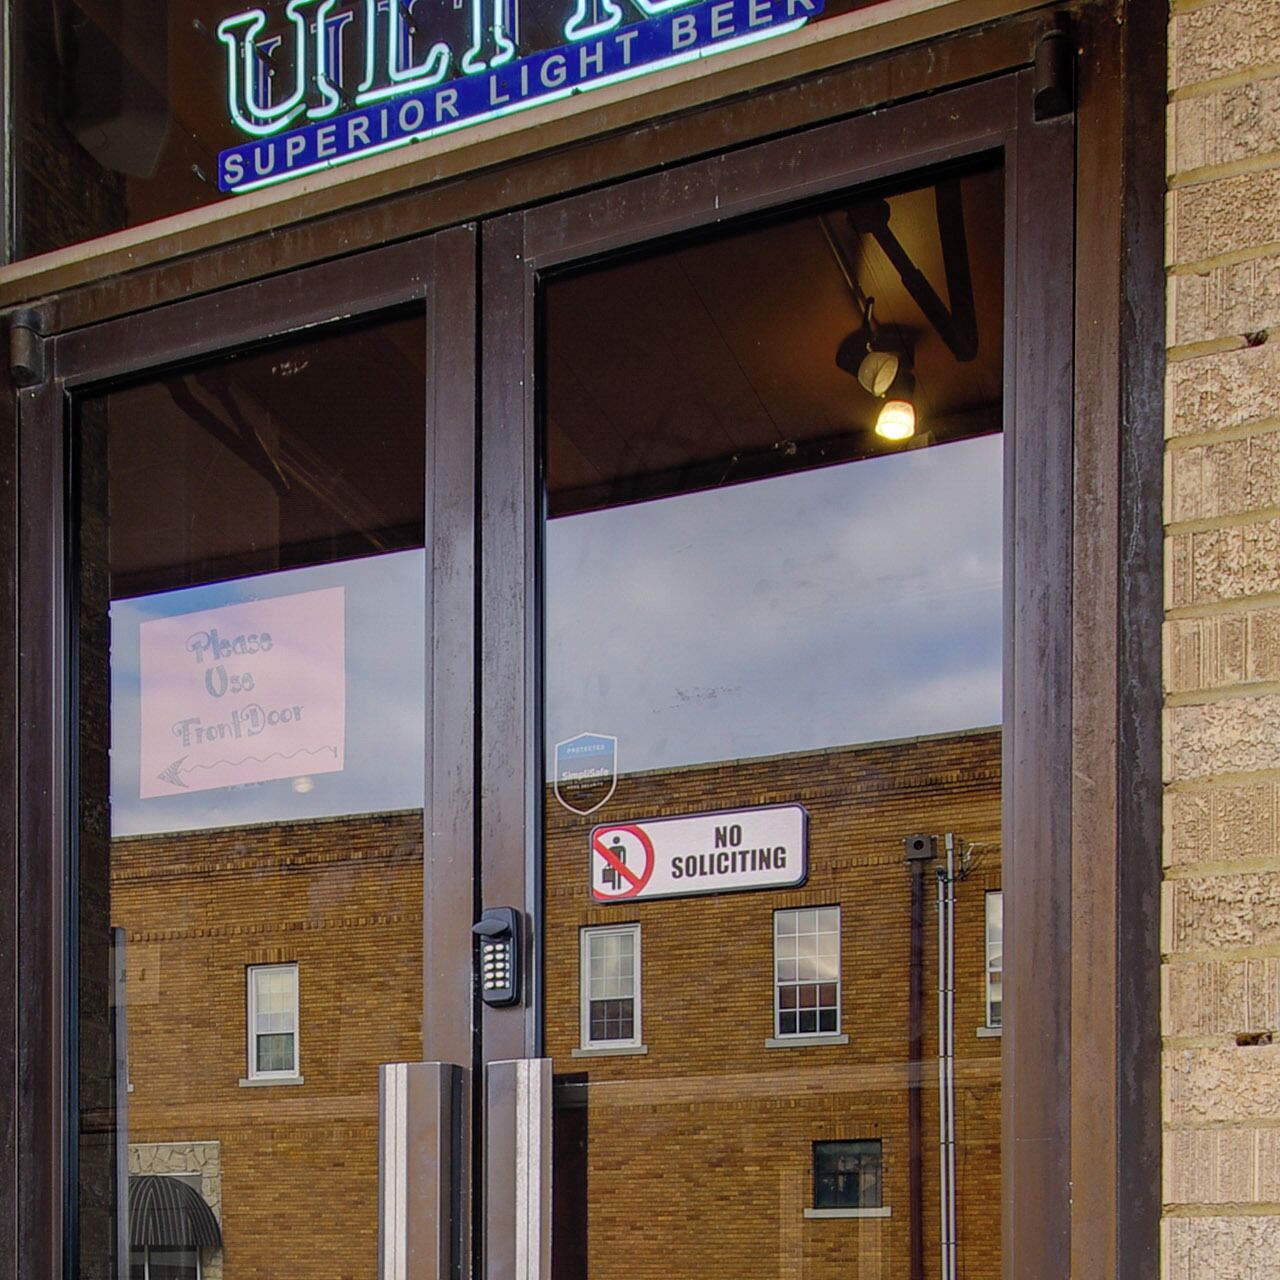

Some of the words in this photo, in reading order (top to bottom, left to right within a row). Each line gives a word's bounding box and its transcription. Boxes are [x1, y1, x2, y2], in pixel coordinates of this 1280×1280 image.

[223, 88, 459, 184] SUPERIOR
[489, 30, 639, 105] LIGHT
[185, 628, 274, 664] Please
[204, 664, 256, 698] Use
[240, 703, 305, 737] Door
[566, 744, 606, 753] PROTECTED
[714, 824, 742, 849] NO
[671, 846, 787, 879] SOLICITING
